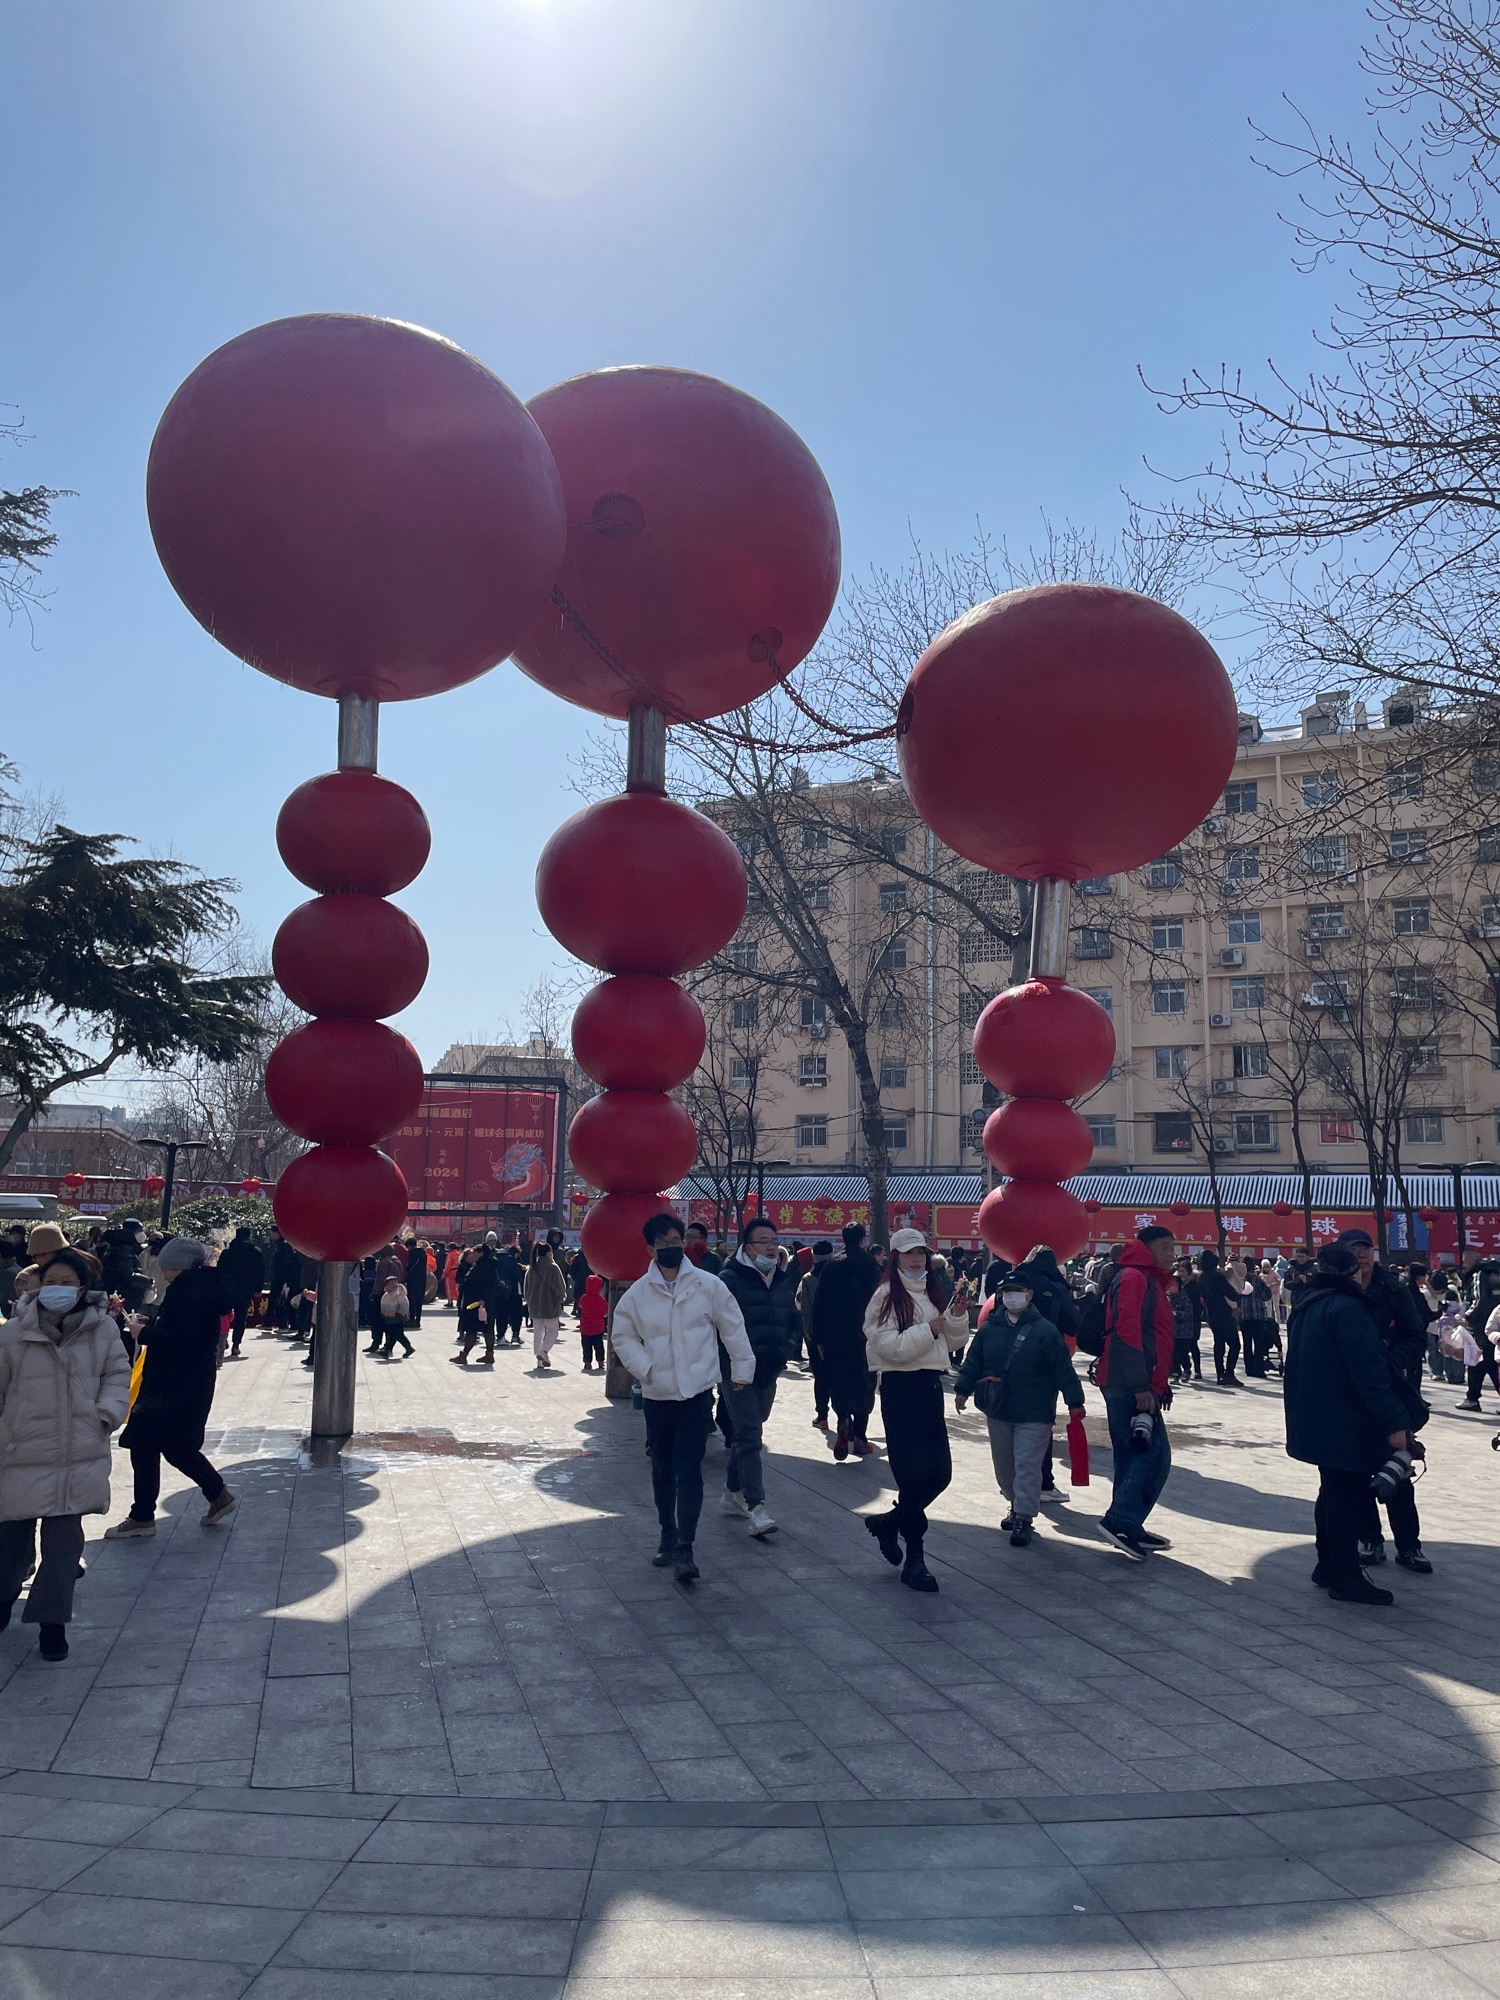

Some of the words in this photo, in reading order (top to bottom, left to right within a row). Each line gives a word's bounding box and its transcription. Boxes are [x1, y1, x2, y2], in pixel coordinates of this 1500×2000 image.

[423, 1167, 460, 1178] 2024
[436, 1180, 445, 1197] 大吉
[778, 1203, 870, 1226] 崔家糖球
